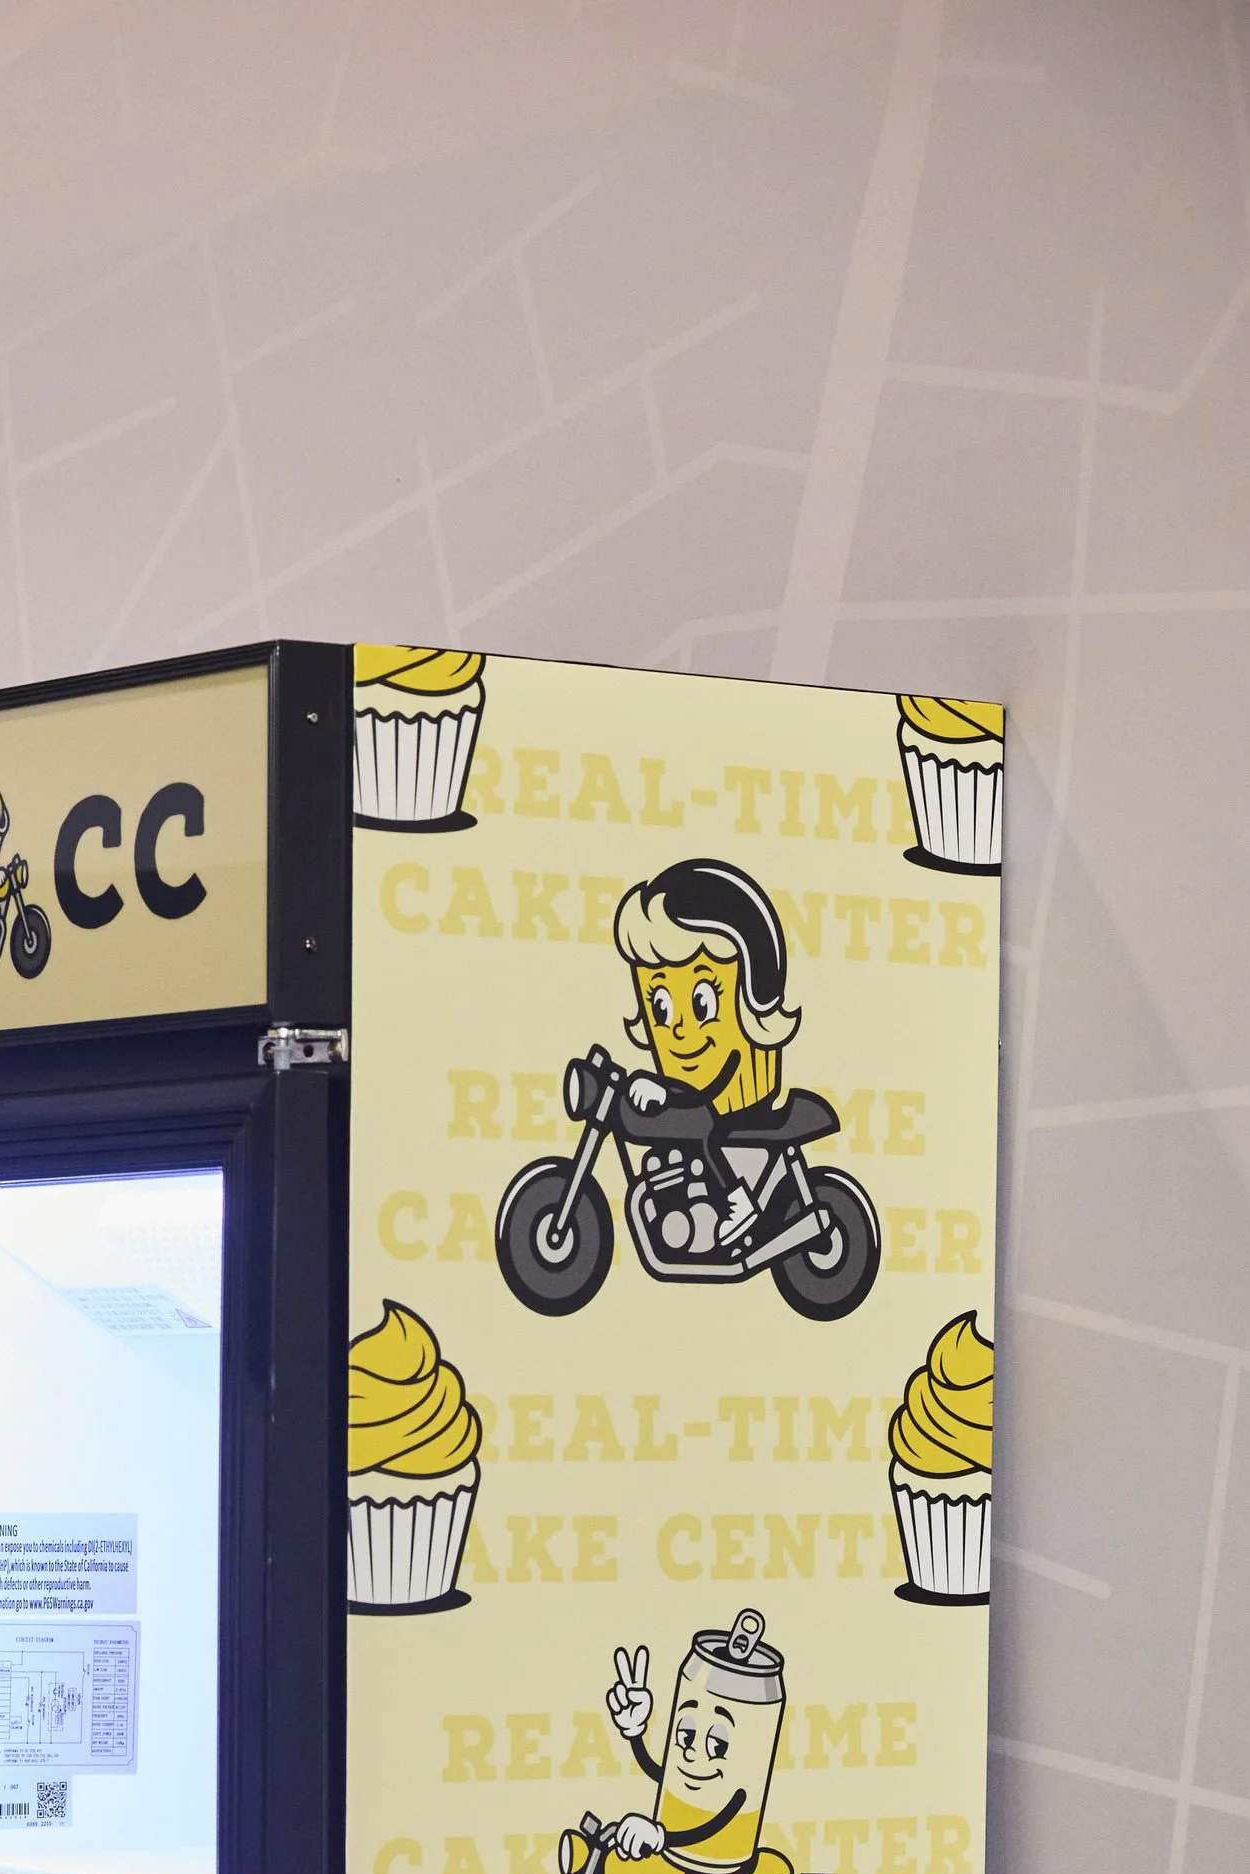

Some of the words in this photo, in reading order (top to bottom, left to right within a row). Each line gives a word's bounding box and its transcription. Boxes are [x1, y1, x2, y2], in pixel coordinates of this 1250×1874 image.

[52, 781, 207, 931] CC
[378, 861, 626, 944] CAKE
[772, 888, 988, 968] NTER
[5, 1543, 22, 1555] expose
[23, 1543, 32, 1555] you
[33, 1541, 39, 1552] to
[39, 1540, 64, 1552] chemicals
[64, 1540, 87, 1556] including
[462, 1513, 618, 1583] AKE
[657, 1513, 909, 1582] CENT
[31, 1559, 48, 1571] known
[49, 1561, 54, 1571] to
[55, 1559, 63, 1571] the
[64, 1559, 77, 1571] State
[78, 1559, 84, 1571] of
[84, 1559, 108, 1571] California
[108, 1561, 114, 1571] to
[114, 1562, 129, 1571] cause
[4, 1577, 22, 1590] defects
[23, 1580, 28, 1590] or
[29, 1577, 43, 1590] other
[44, 1577, 76, 1592] reproductive
[76, 1577, 91, 1590] harm.
[16, 1600, 23, 1613] go
[23, 1598, 29, 1609] to
[29, 1597, 94, 1612] www.P65Warnings.ca.gov
